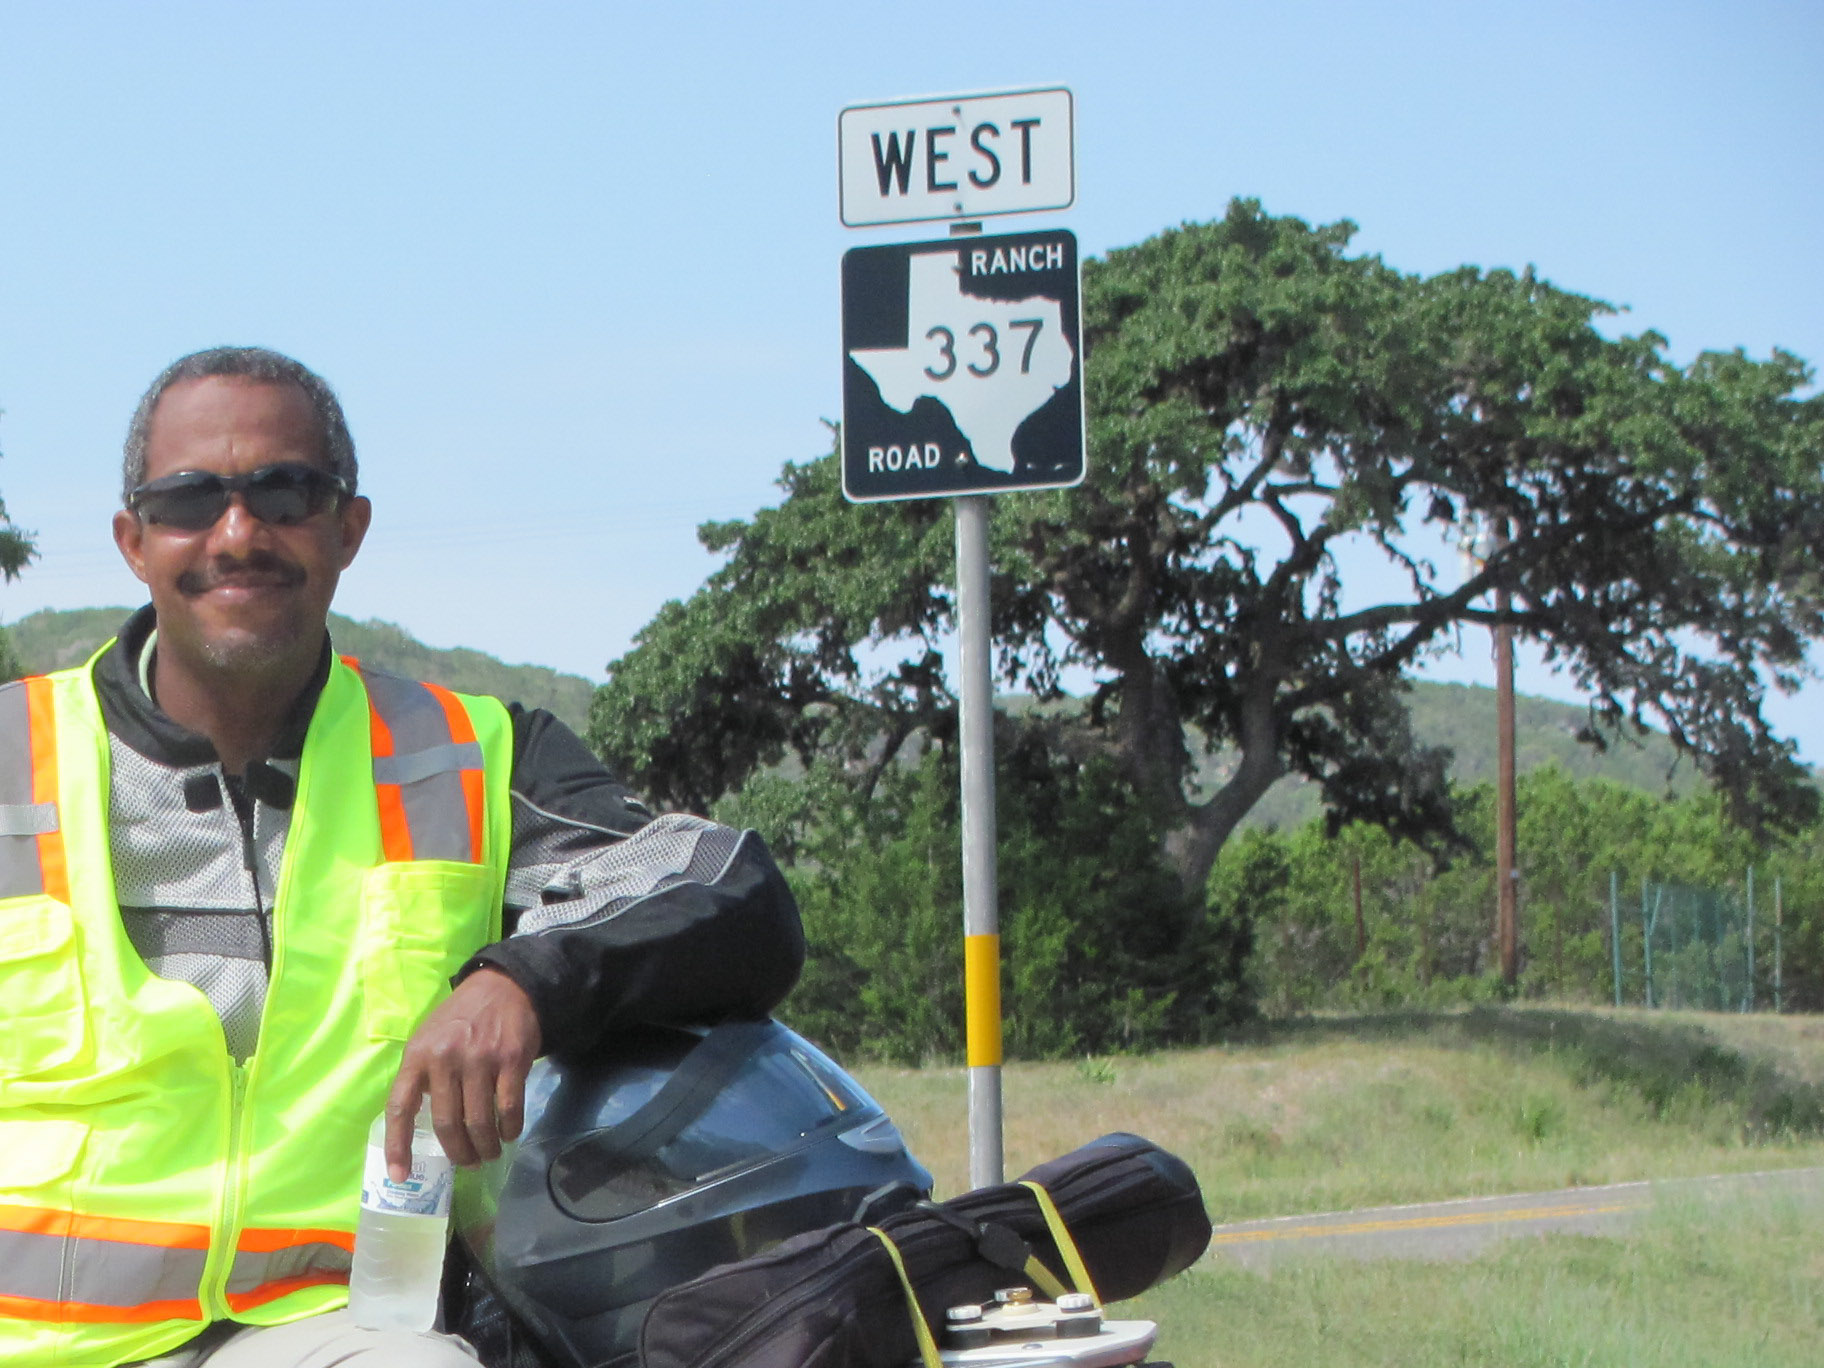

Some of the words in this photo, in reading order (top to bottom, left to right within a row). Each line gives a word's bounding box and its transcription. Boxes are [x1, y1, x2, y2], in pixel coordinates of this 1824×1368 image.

[870, 117, 1042, 198] WEST
[970, 243, 1064, 276] RANCH
[923, 318, 1045, 381] 337
[868, 442, 941, 473] ROAD
